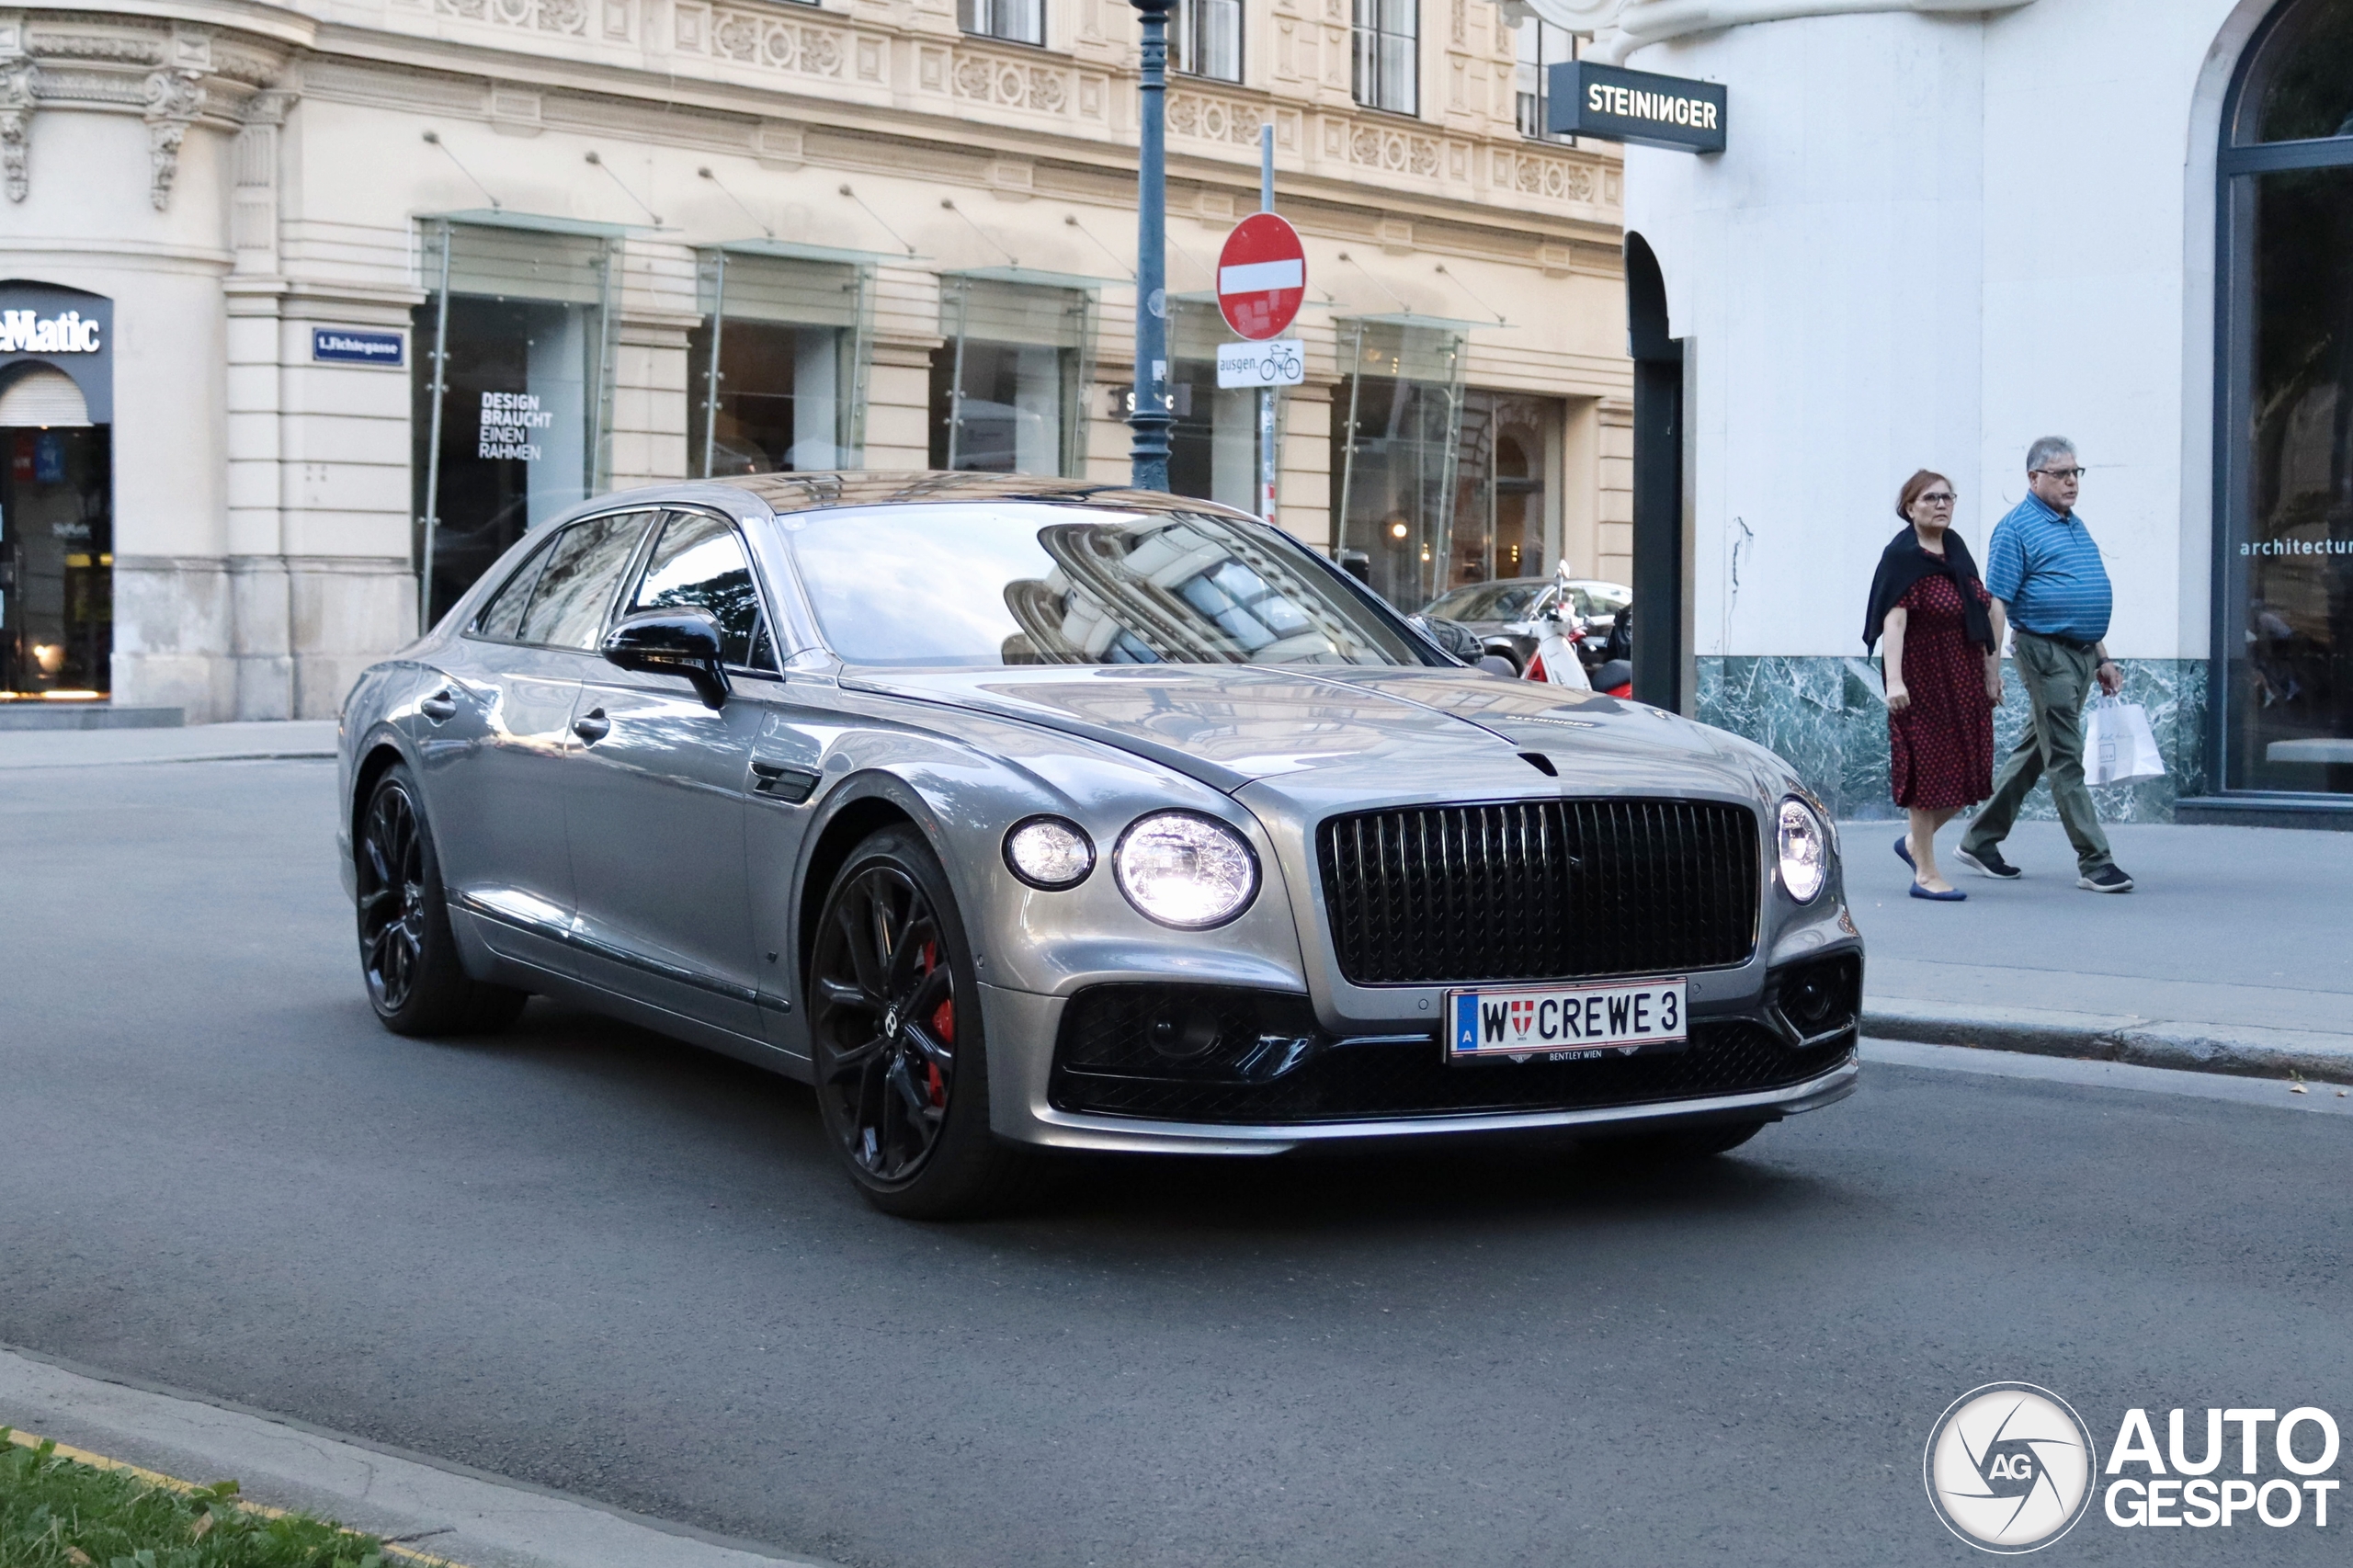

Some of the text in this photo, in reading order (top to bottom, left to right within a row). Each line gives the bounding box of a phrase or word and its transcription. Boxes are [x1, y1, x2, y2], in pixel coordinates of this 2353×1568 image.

[1220, 358, 1259, 373] ausgen.
[482, 392, 540, 411] DESIGN
[481, 409, 553, 428] BRAUCHT
[479, 426, 525, 443] EINEN
[478, 442, 541, 460] RAHMEN
[1482, 991, 1678, 1043] W CREWE 3
[1461, 1029, 1472, 1043] A
[1549, 1050, 1602, 1062] BENTLEY WIEN
